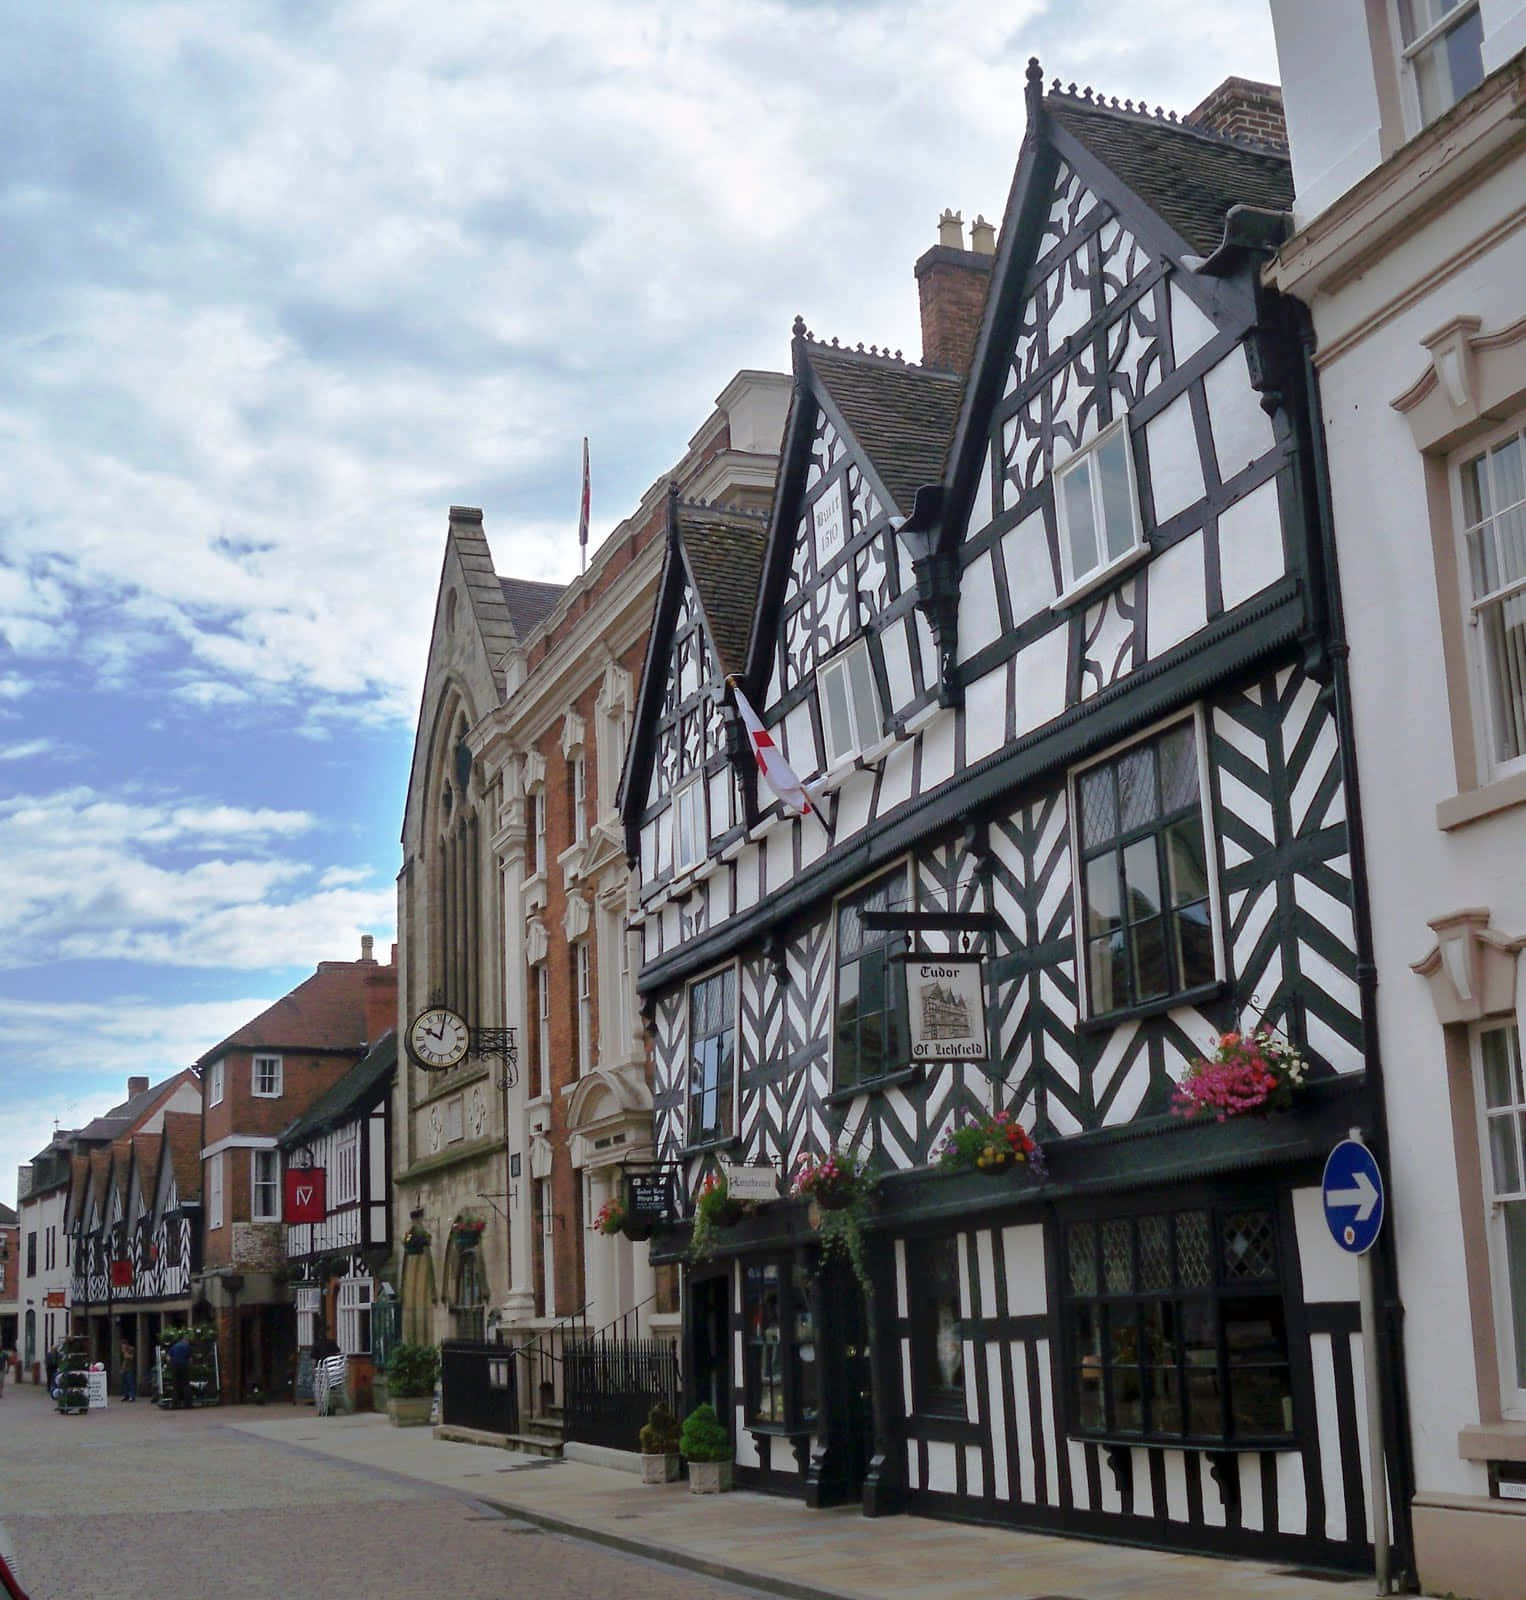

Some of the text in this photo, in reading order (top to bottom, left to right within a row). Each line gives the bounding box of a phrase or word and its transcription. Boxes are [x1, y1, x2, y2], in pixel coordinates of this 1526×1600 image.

[821, 523, 838, 551] 1510
[920, 966, 960, 978] Tudor
[913, 1043, 982, 1056] Of Lichfield
